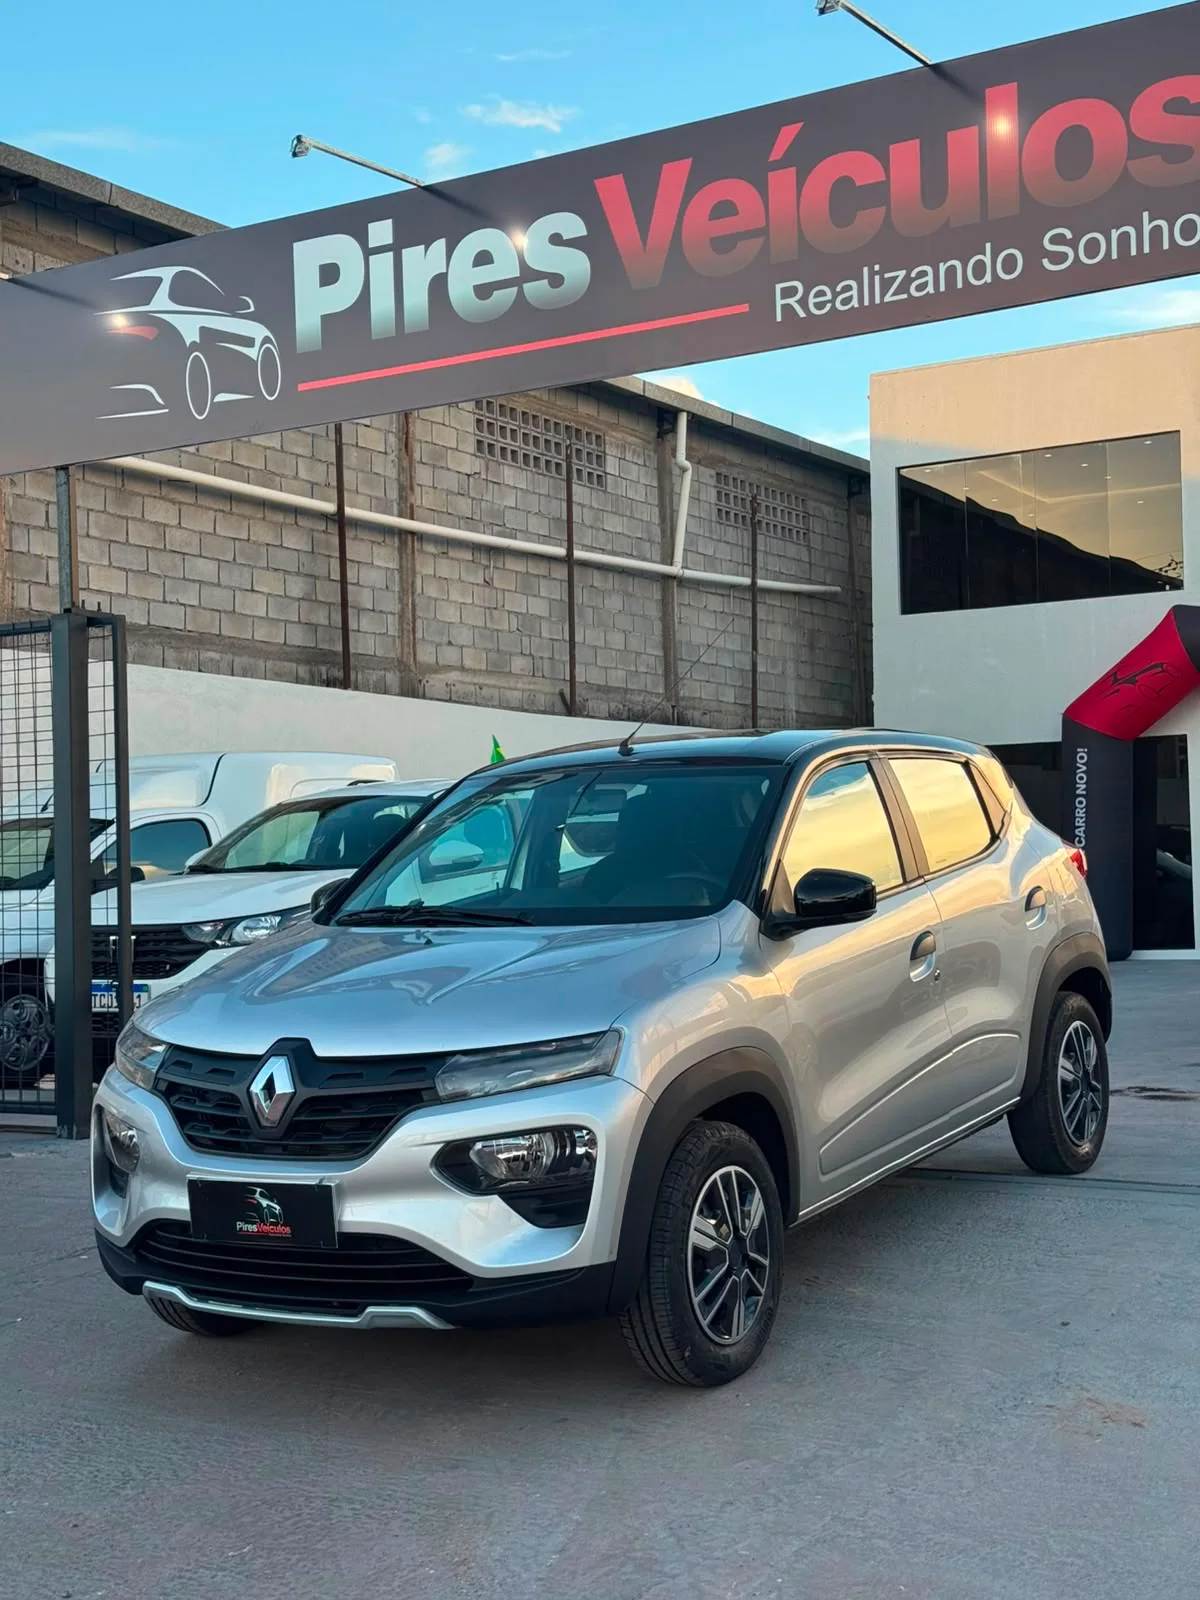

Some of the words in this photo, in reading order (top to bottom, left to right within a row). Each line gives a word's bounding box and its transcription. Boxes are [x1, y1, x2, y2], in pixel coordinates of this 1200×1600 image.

[774, 242, 1024, 322] Realizando
[1075, 748, 1088, 795] NOVO!
[1074, 797, 1087, 848] CARRO
